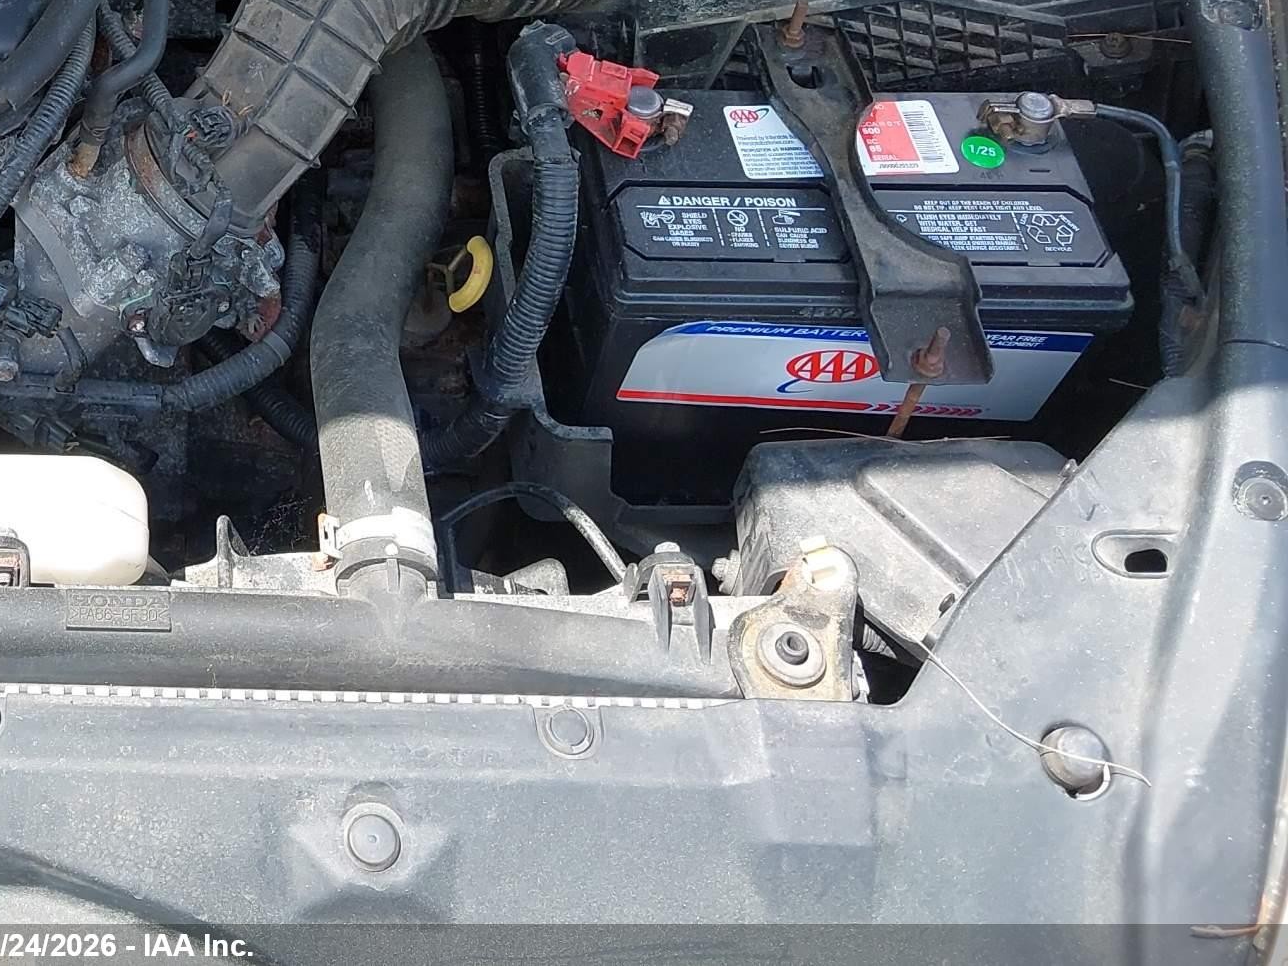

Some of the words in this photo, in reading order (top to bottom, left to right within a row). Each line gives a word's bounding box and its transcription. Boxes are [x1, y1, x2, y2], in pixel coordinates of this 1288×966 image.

[730, 109, 759, 123] AAA
[967, 143, 997, 158] 1/25
[672, 196, 731, 206] DANGER
[732, 197, 742, 207] /
[744, 197, 797, 208] POISON
[915, 213, 938, 221] FLUSH
[938, 213, 956, 221] EYES
[706, 325, 794, 335] PREMIUM
[793, 328, 870, 338] BATTER
[1016, 335, 1049, 343] FREE
[791, 351, 870, 382] AAA
[70, 593, 170, 608] HONDA
